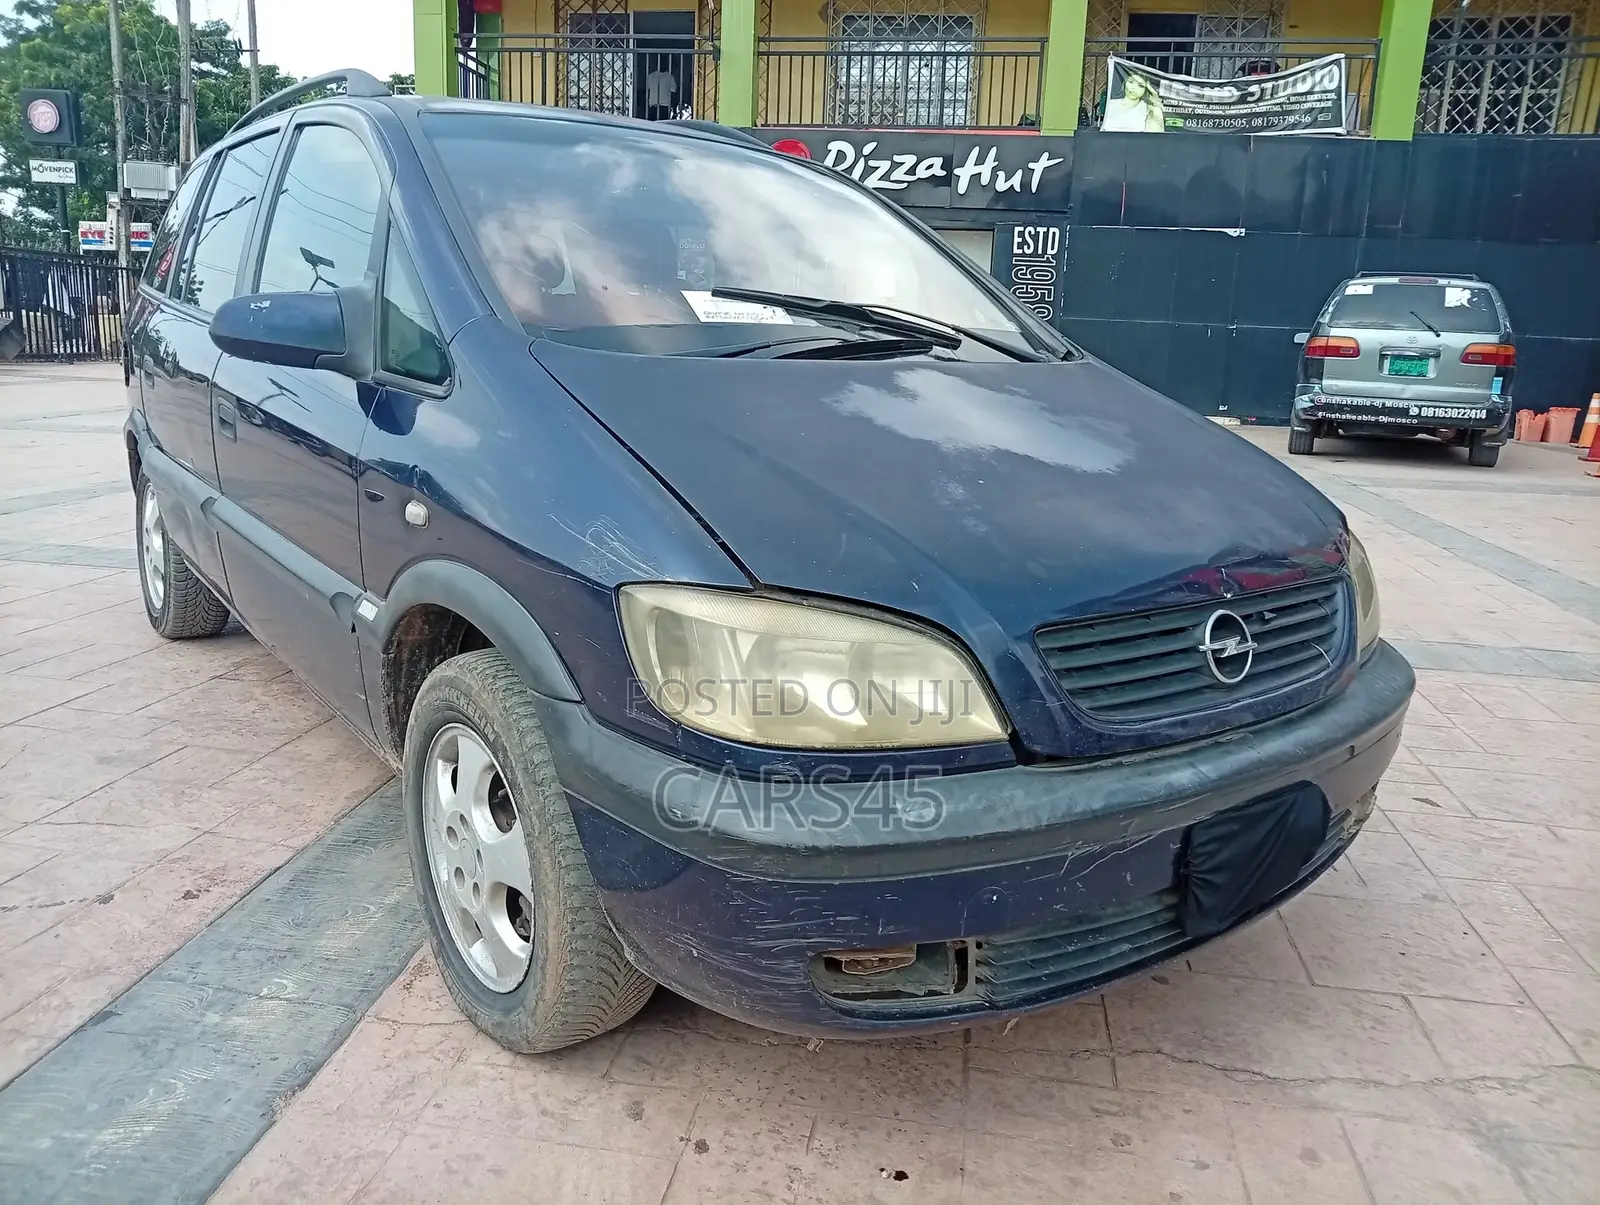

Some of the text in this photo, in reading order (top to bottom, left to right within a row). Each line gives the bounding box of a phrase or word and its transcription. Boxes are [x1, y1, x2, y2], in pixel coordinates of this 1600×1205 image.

[1247, 64, 1340, 102] STUDIO
[1252, 113, 1311, 127] 08179379546
[822, 140, 1064, 195] Pizza Hut
[1013, 226, 1060, 255] ESTD
[1420, 406, 1487, 419] 08163022414
